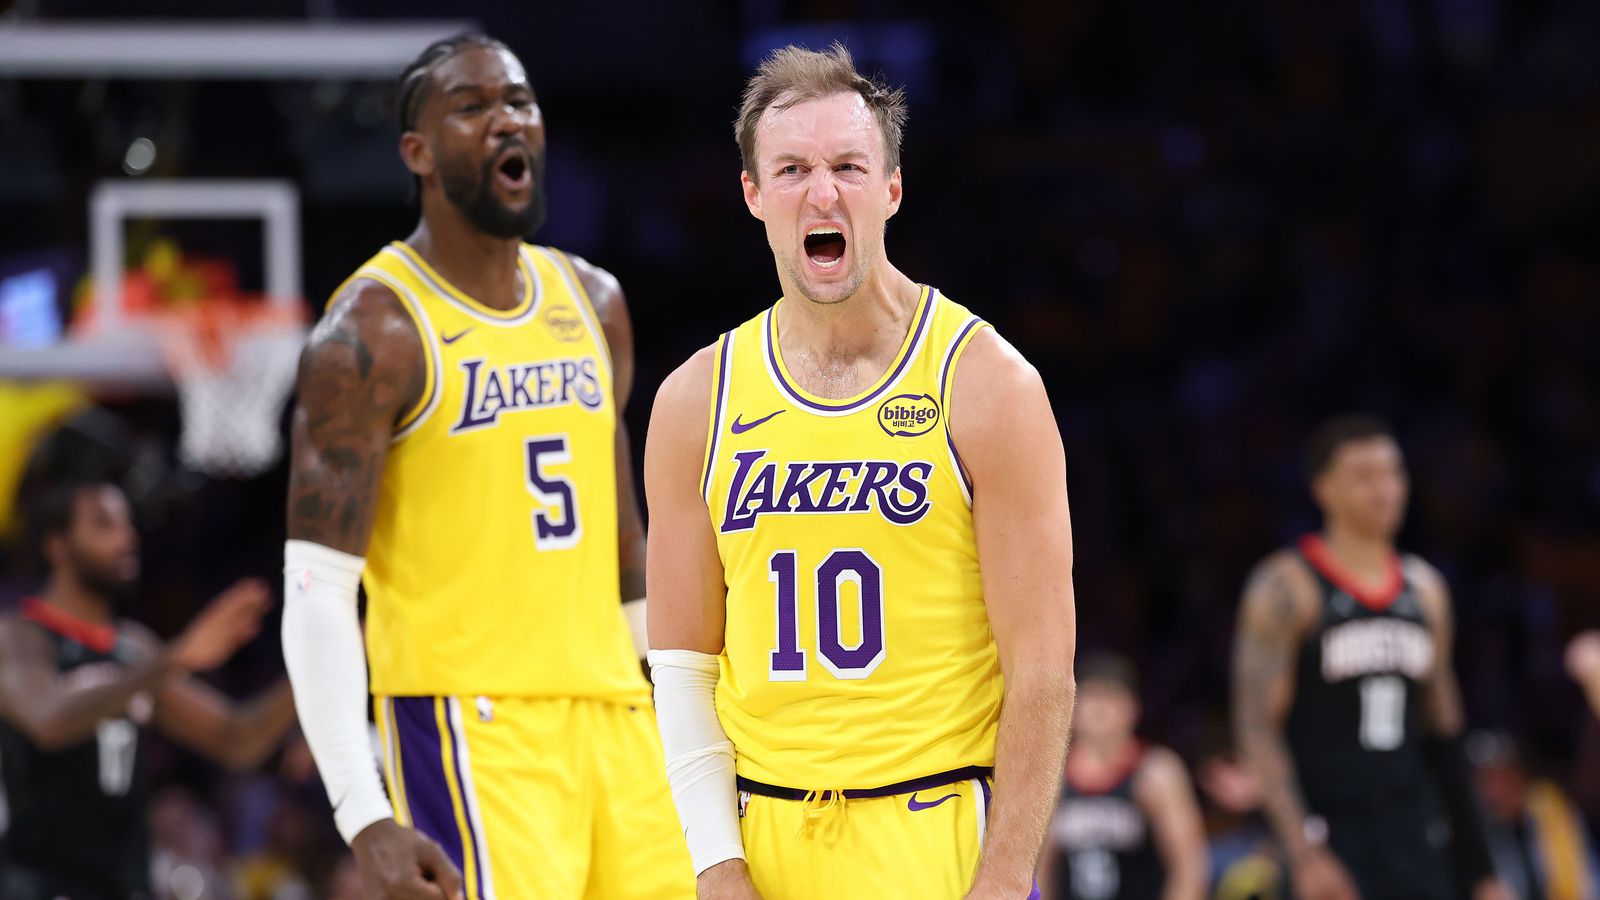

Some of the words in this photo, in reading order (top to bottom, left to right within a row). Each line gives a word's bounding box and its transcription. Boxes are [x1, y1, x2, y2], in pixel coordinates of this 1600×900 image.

[451, 358, 606, 432] LAKERS
[884, 405, 937, 424] bibigo
[892, 420, 915, 428] 비비고
[524, 435, 583, 551] 5
[719, 448, 935, 534] LAKERS
[768, 548, 887, 682] 10
